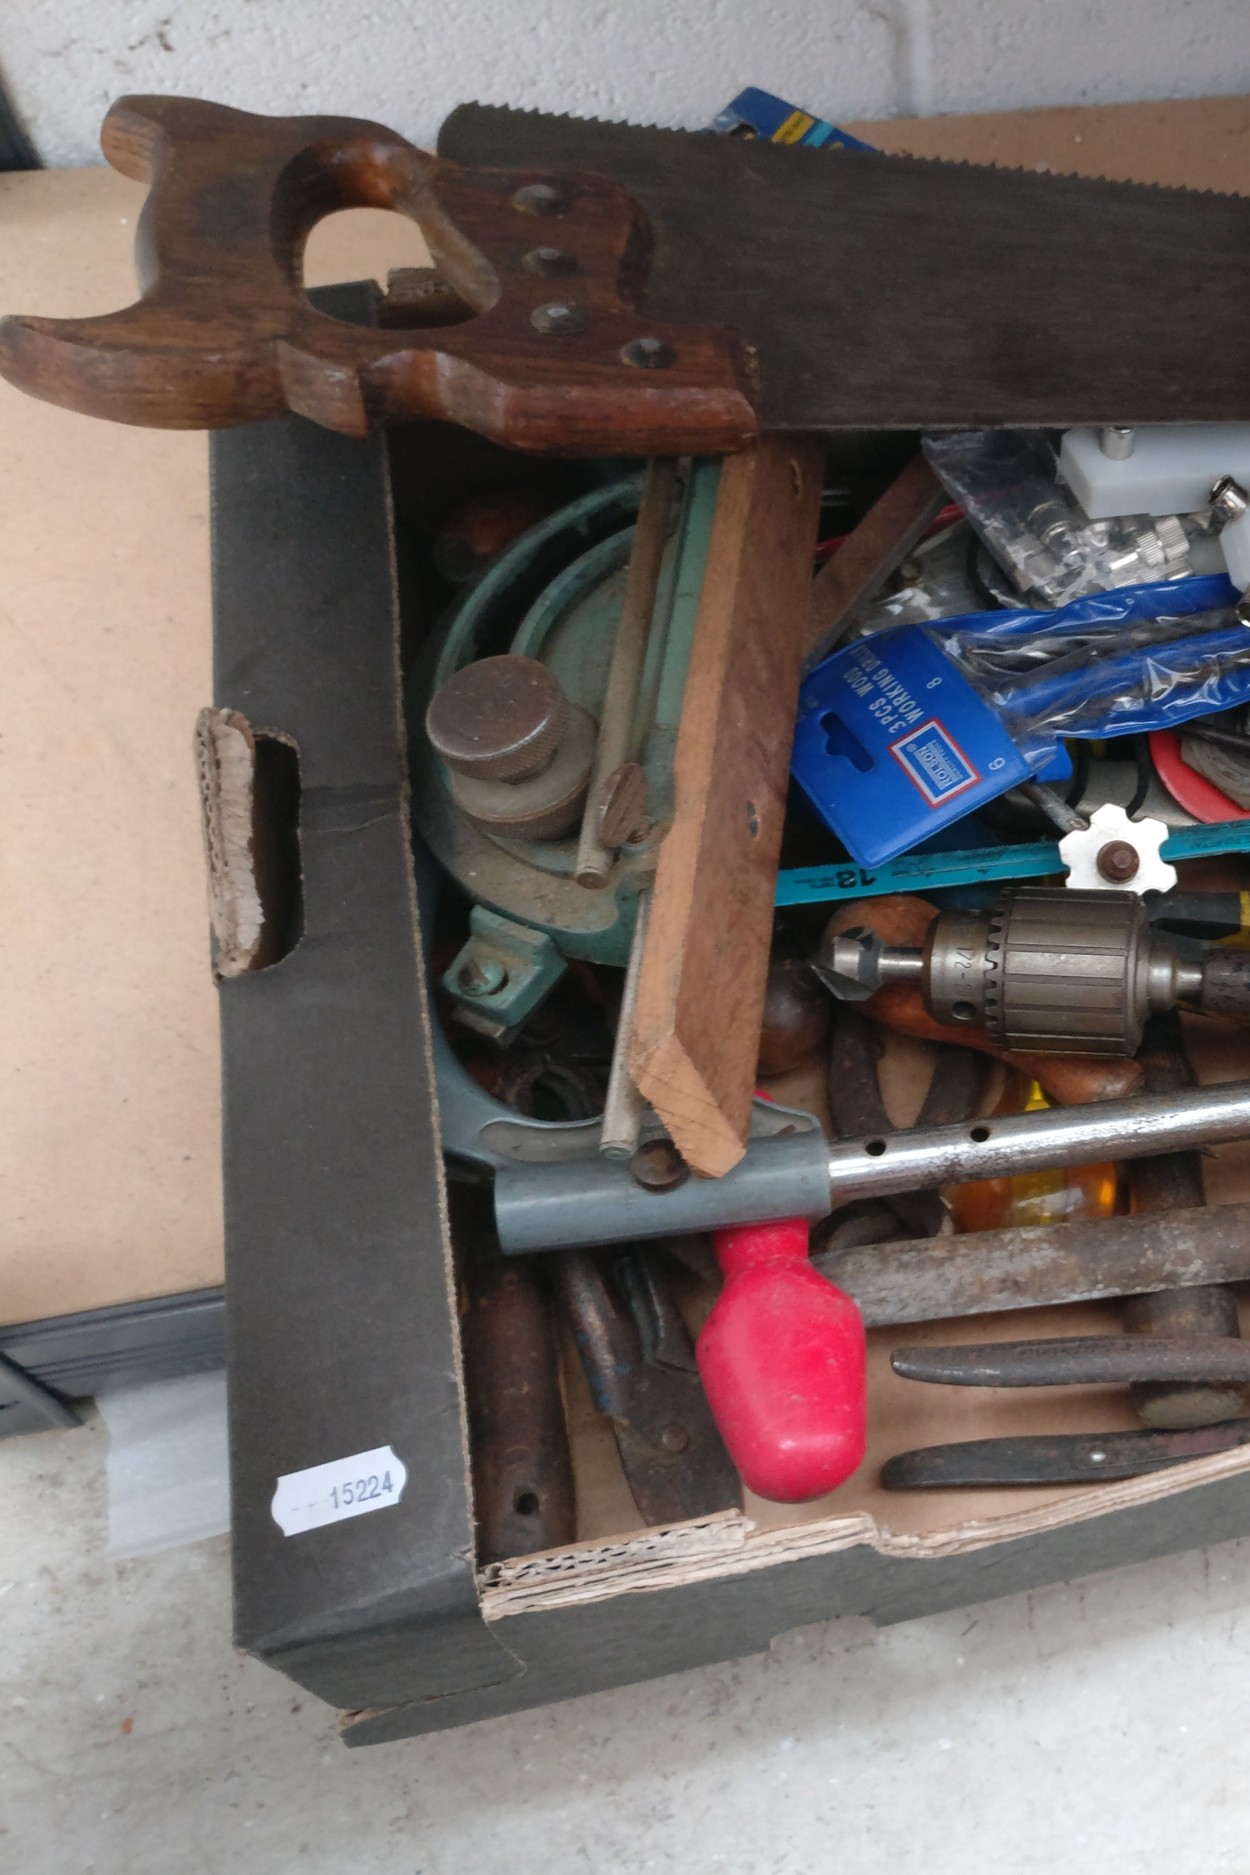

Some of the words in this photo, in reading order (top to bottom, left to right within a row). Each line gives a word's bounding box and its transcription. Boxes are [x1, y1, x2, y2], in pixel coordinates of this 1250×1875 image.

[843, 666, 875, 697] WOOD
[926, 676, 944, 690] 8
[871, 667, 925, 724] WORKING
[987, 756, 1006, 771] 6
[836, 868, 877, 889] 18
[329, 1469, 394, 1509] 15224
